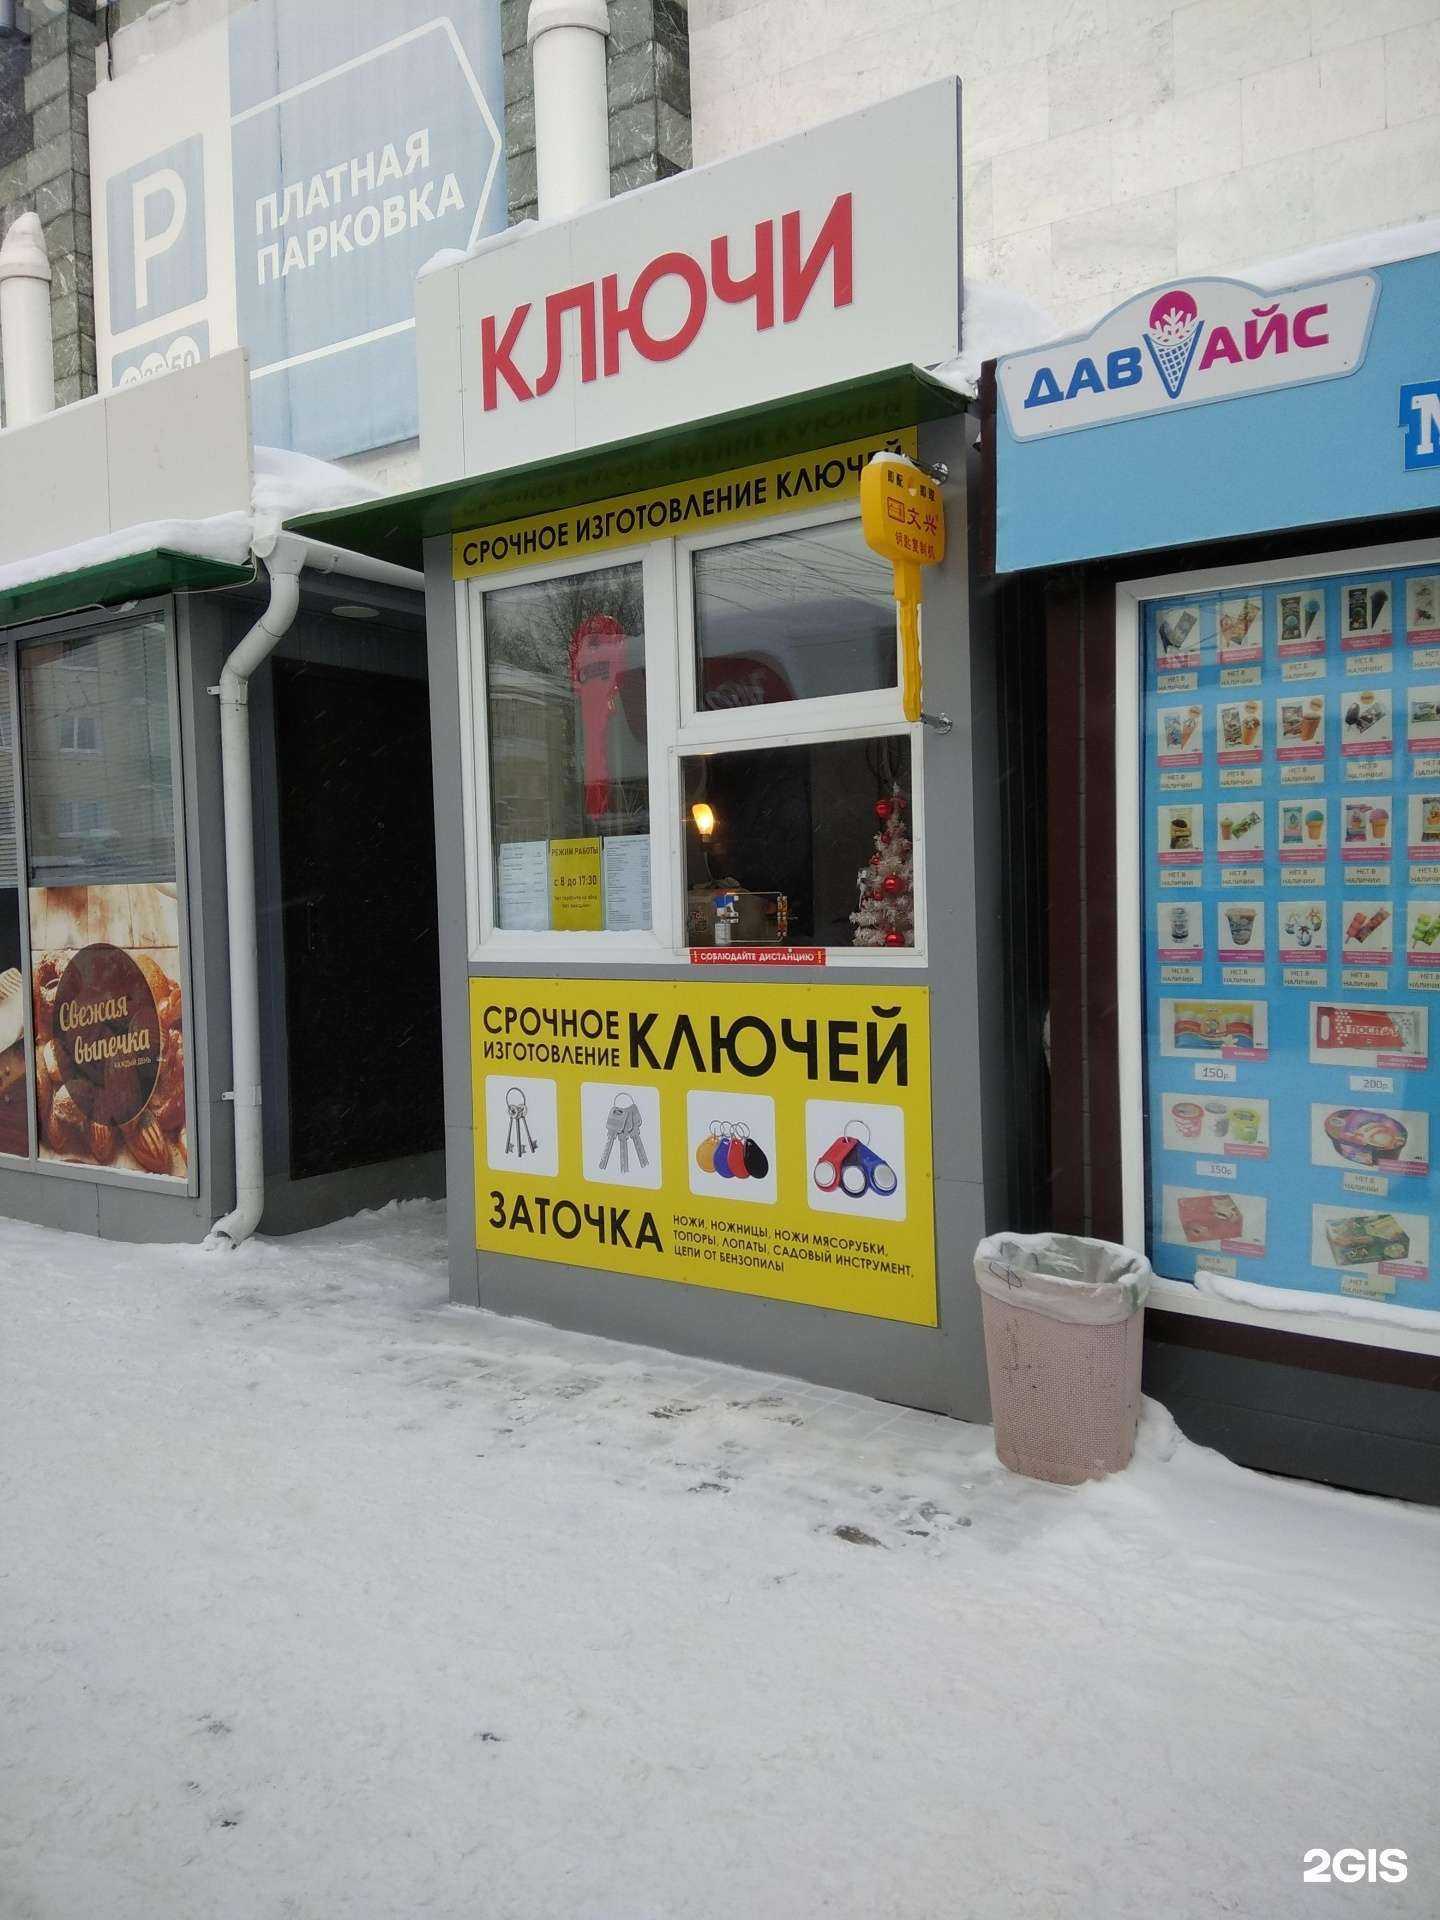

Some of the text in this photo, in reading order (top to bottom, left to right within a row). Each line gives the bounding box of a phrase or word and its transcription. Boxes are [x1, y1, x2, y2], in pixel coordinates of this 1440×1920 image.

[255, 128, 430, 235] ПЛАТНАЯ
[132, 167, 188, 310] P
[256, 172, 466, 286] ПАРКОВКА
[480, 191, 854, 412] КЛЮЧИ
[463, 438, 902, 566] СРОЧНОЕ ИЗГОТОВЛЕНИЕ КЛЮЧ
[700, 951, 756, 961] СОБЛЮДАЙТЕ
[759, 952, 815, 962] ДИСТАНЦИЮ
[59, 995, 129, 1031] Свежая
[483, 1005, 620, 1041] СРОЧНОЕ
[74, 1028, 151, 1065] выпечка
[483, 1041, 621, 1067] ИЗГОТОВЛЕНИЕ
[629, 1005, 909, 1087] КЛЮЧЕЙ
[489, 1190, 664, 1253] ЗАТОЧКА
[674, 1246, 784, 1272] ЦЕПИ ОТ БЕНЗОПИЛЫ
[773, 1245, 832, 1263] САДОВЫЙ
[836, 1256, 914, 1278] ИНСТРУМЕНТ,
[774, 1230, 809, 1243] НОЖИ
[813, 1235, 888, 1256] МЯСОРУБКИ,
